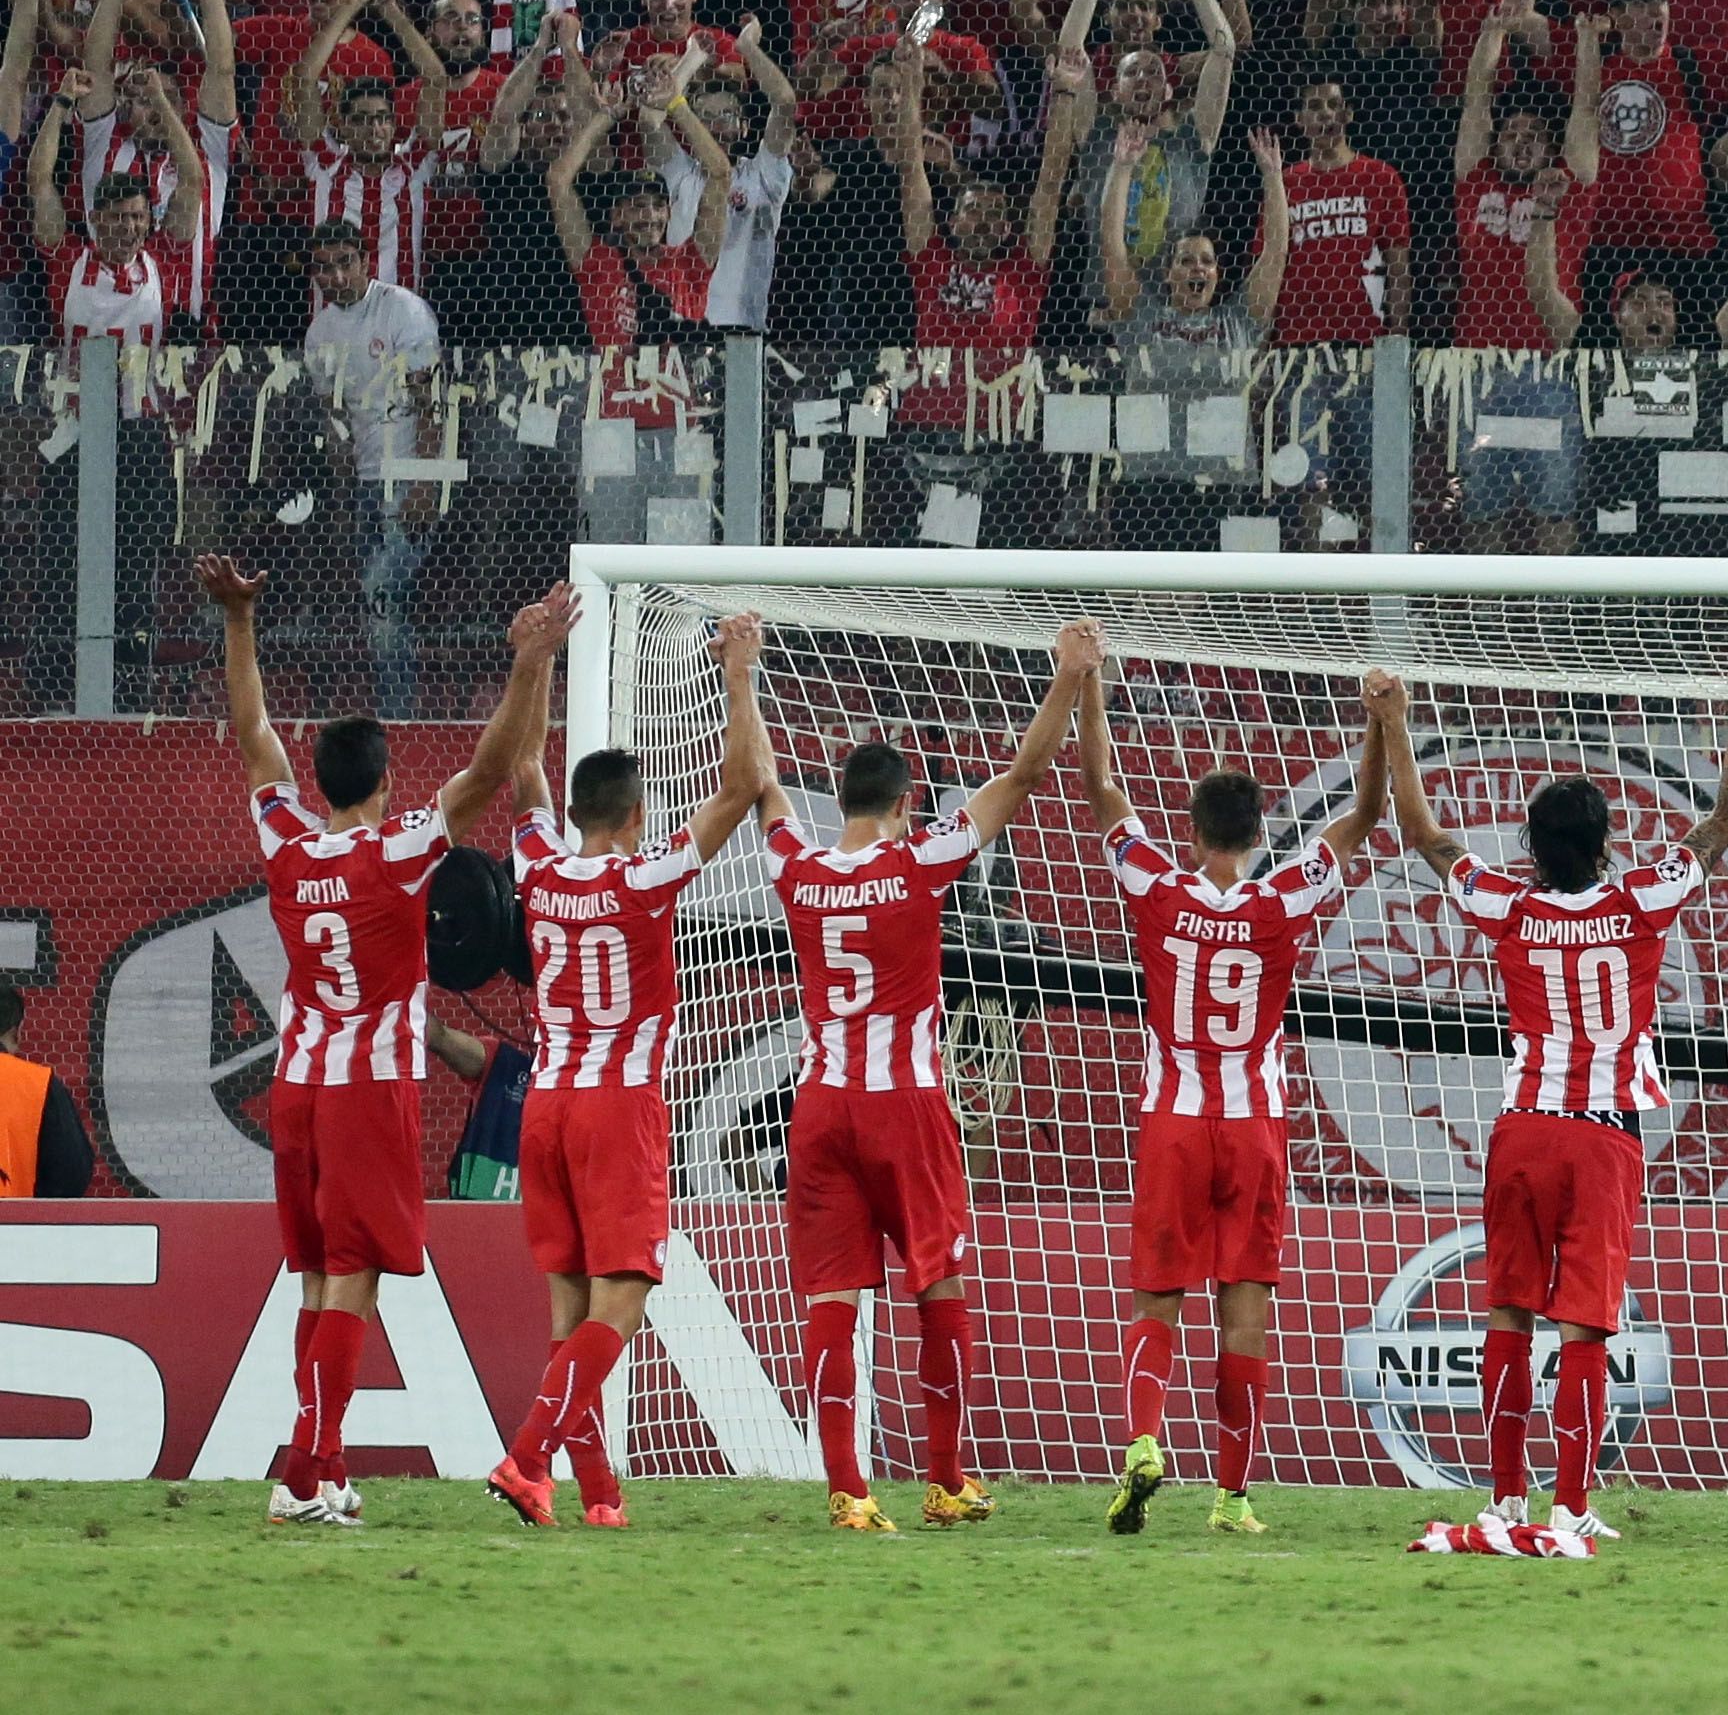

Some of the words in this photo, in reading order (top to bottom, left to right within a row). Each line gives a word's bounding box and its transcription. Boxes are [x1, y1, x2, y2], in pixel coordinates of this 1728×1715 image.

[1288, 195, 1367, 225] NEMEA
[1307, 217, 1369, 241] CLUB
[303, 912, 361, 1012] 3
[532, 921, 632, 1027] 20
[819, 914, 877, 1018] 5
[1519, 913, 1636, 946] DOMINGUEZ
[1161, 935, 1263, 1047] 19
[1527, 946, 1631, 1046] 10
[1376, 1345, 1638, 1388] NISN
